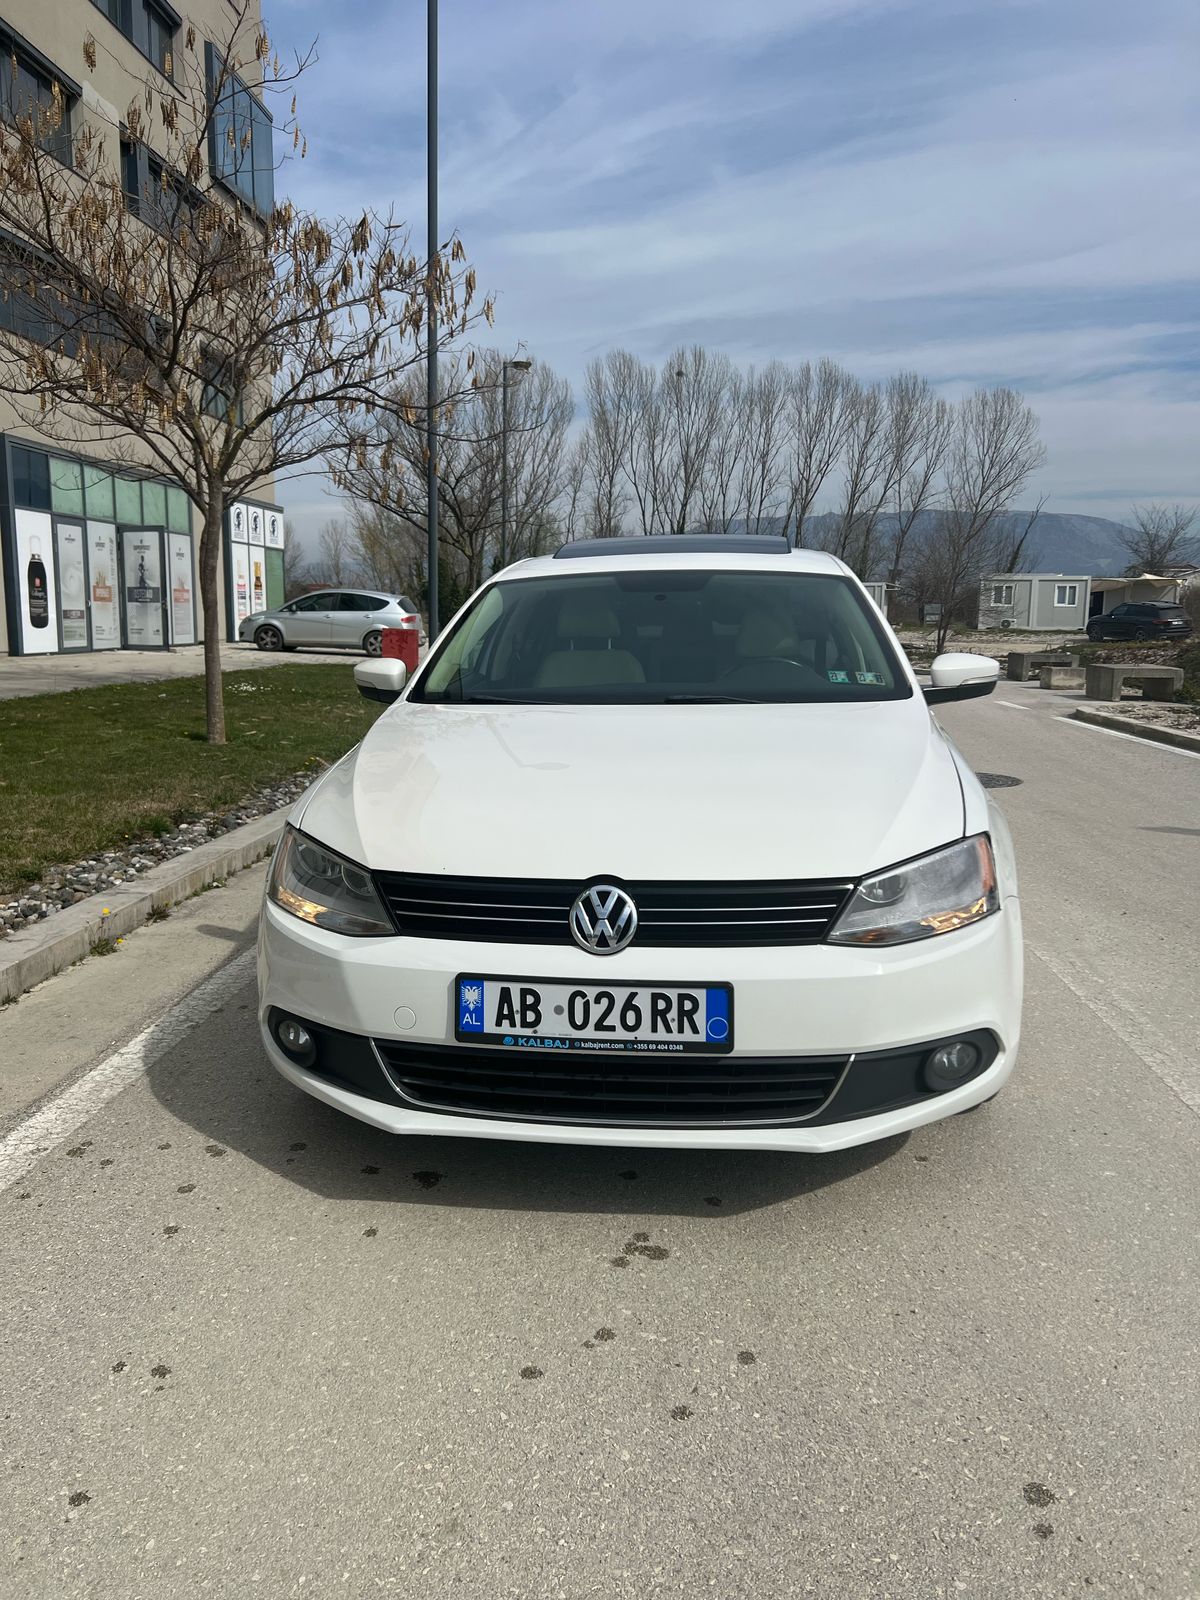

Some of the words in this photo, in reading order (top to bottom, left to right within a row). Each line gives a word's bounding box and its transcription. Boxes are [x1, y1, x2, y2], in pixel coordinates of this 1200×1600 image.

[495, 986, 542, 1029] AB
[568, 990, 642, 1033] 026
[650, 992, 700, 1035] RR
[463, 1013, 481, 1025] AL
[518, 1037, 569, 1049] KALBAJ
[581, 1041, 625, 1050] kalbajrent.com
[633, 1043, 648, 1051] +355
[648, 1043, 656, 1051] 69
[656, 1043, 669, 1051] 404
